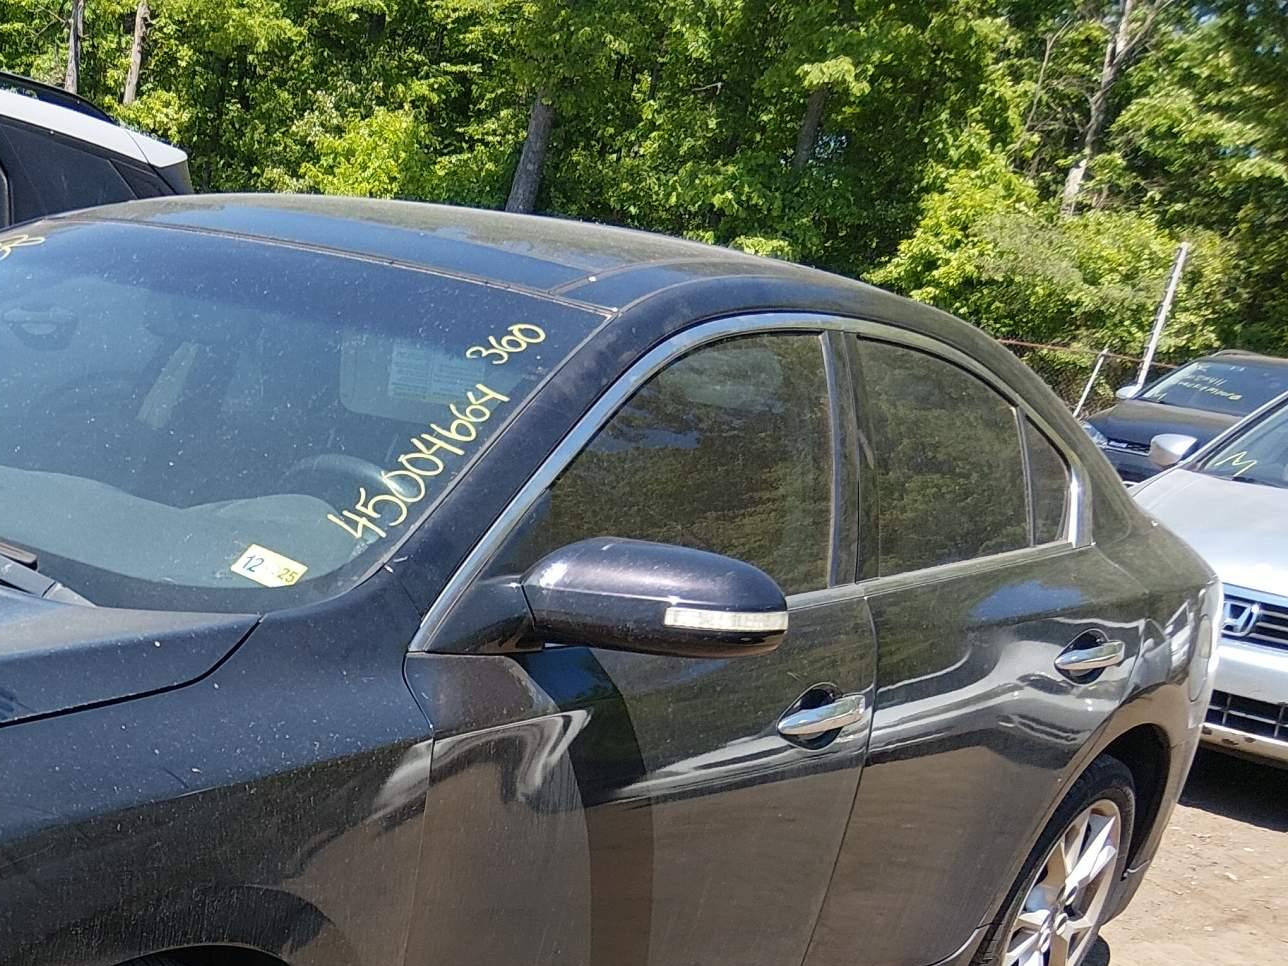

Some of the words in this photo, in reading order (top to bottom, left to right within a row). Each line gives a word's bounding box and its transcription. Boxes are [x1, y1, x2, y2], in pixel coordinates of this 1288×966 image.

[327, 384, 511, 539] 45004664
[466, 323, 547, 365] 360
[242, 554, 265, 573] 12
[276, 567, 299, 583] 25
